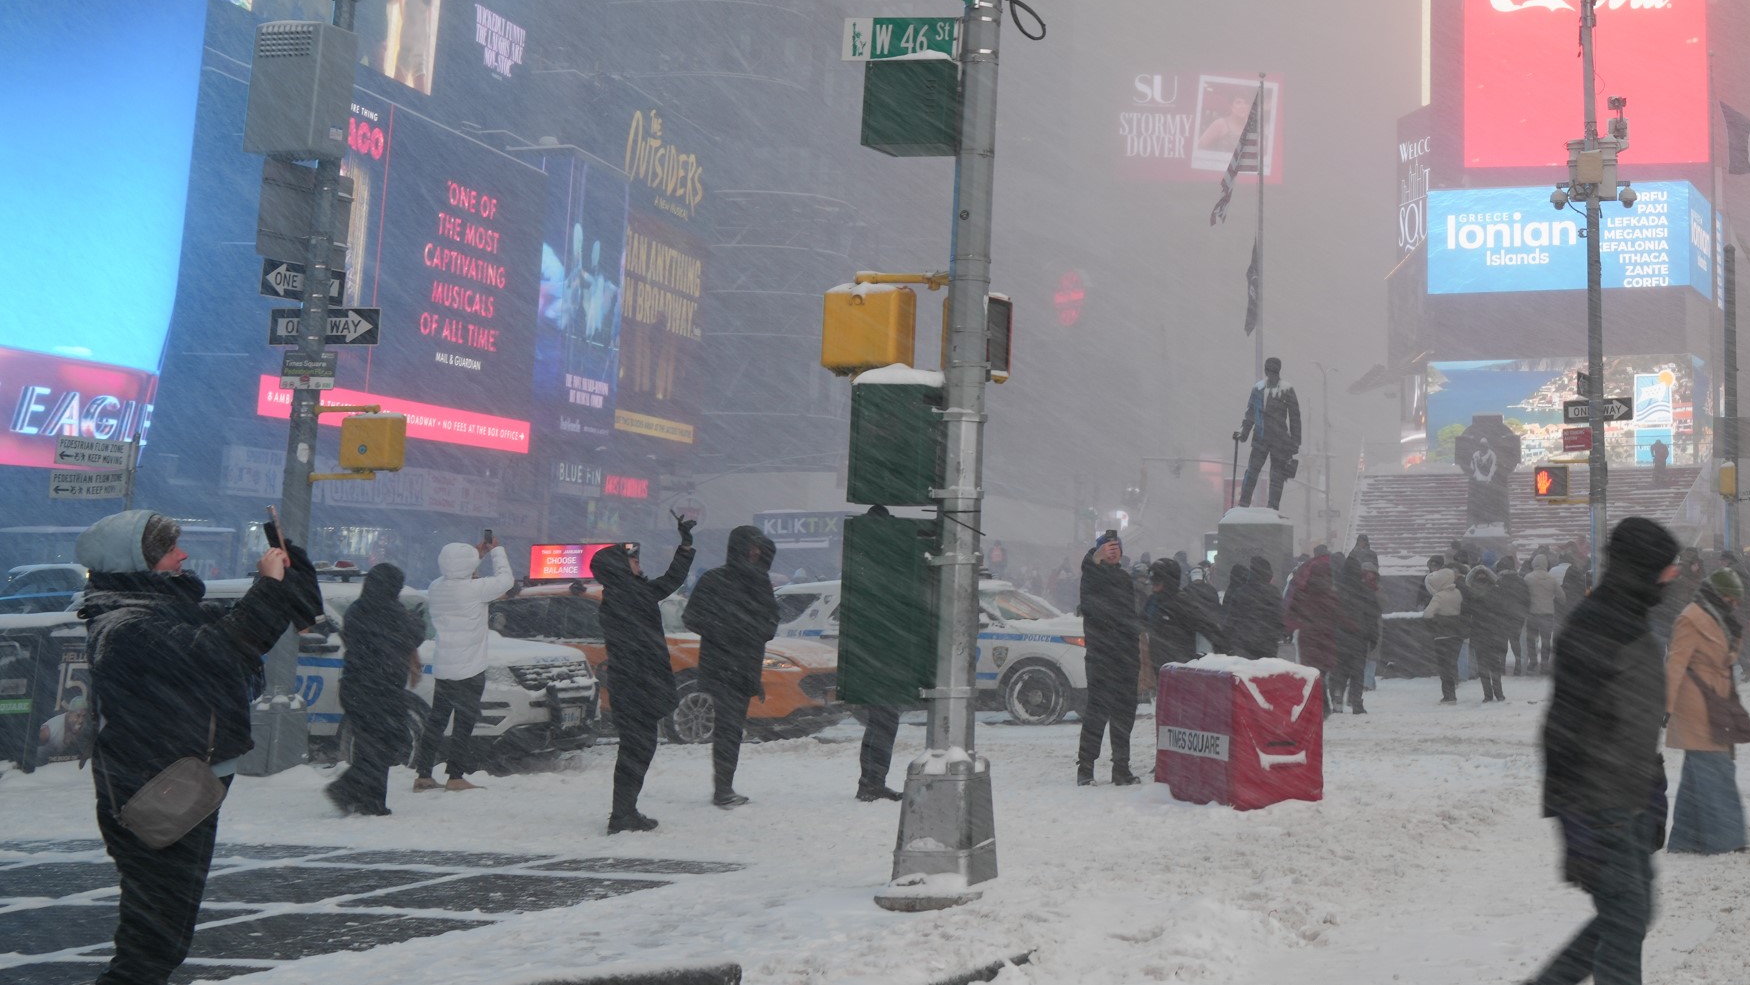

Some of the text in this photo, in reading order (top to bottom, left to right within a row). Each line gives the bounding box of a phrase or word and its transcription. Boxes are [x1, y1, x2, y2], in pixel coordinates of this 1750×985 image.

[876, 22, 950, 54] W 46 St
[1132, 73, 1178, 105] SU
[361, 107, 378, 122] THING
[1119, 112, 1193, 137] STORMY
[1126, 134, 1186, 159] DOVER
[1634, 191, 1668, 201] ORFU
[480, 195, 498, 220] OF
[1638, 203, 1668, 214] PAXI
[1458, 212, 1510, 223] GREECE
[1607, 216, 1668, 227] LEFKADA
[438, 211, 500, 255] THE MOST
[1446, 212, 1577, 250] Ionian
[1604, 228, 1668, 240] MEGANISI
[1486, 248, 1550, 267] Islands
[1619, 252, 1669, 263] ITHACA
[423, 242, 506, 289] CAPTIVATING
[650, 240, 701, 298] ANYTHING
[1625, 265, 1669, 276] ZANTE
[275, 272, 298, 289] ONE
[1623, 277, 1669, 288] CORFU
[431, 280, 495, 319] MUSICALS
[330, 320, 361, 334] WAY
[419, 312, 440, 336] OF
[441, 318, 464, 344] ALL
[304, 361, 327, 369] Square
[435, 351, 482, 371] MAIL GUARDIAN
[443, 421, 453, 430] NO
[453, 422, 466, 432] FEES
[468, 424, 476, 433] AT
[477, 425, 486, 436] THE
[488, 427, 499, 438] BOX
[500, 429, 519, 441] OFFICE
[60, 439, 124, 454] PEDESTRIAN FLOW ZONE
[88, 452, 123, 465] KEEP MOVING
[53, 473, 93, 484] PEDESTRIAN
[559, 462, 583, 483] BLUE
[86, 486, 103, 495] KEEP
[546, 557, 577, 566] CHOOSE
[543, 566, 579, 575] BALANCE
[1023, 633, 1051, 643] POLICE
[1168, 728, 1220, 755] TIMES SQUARE
